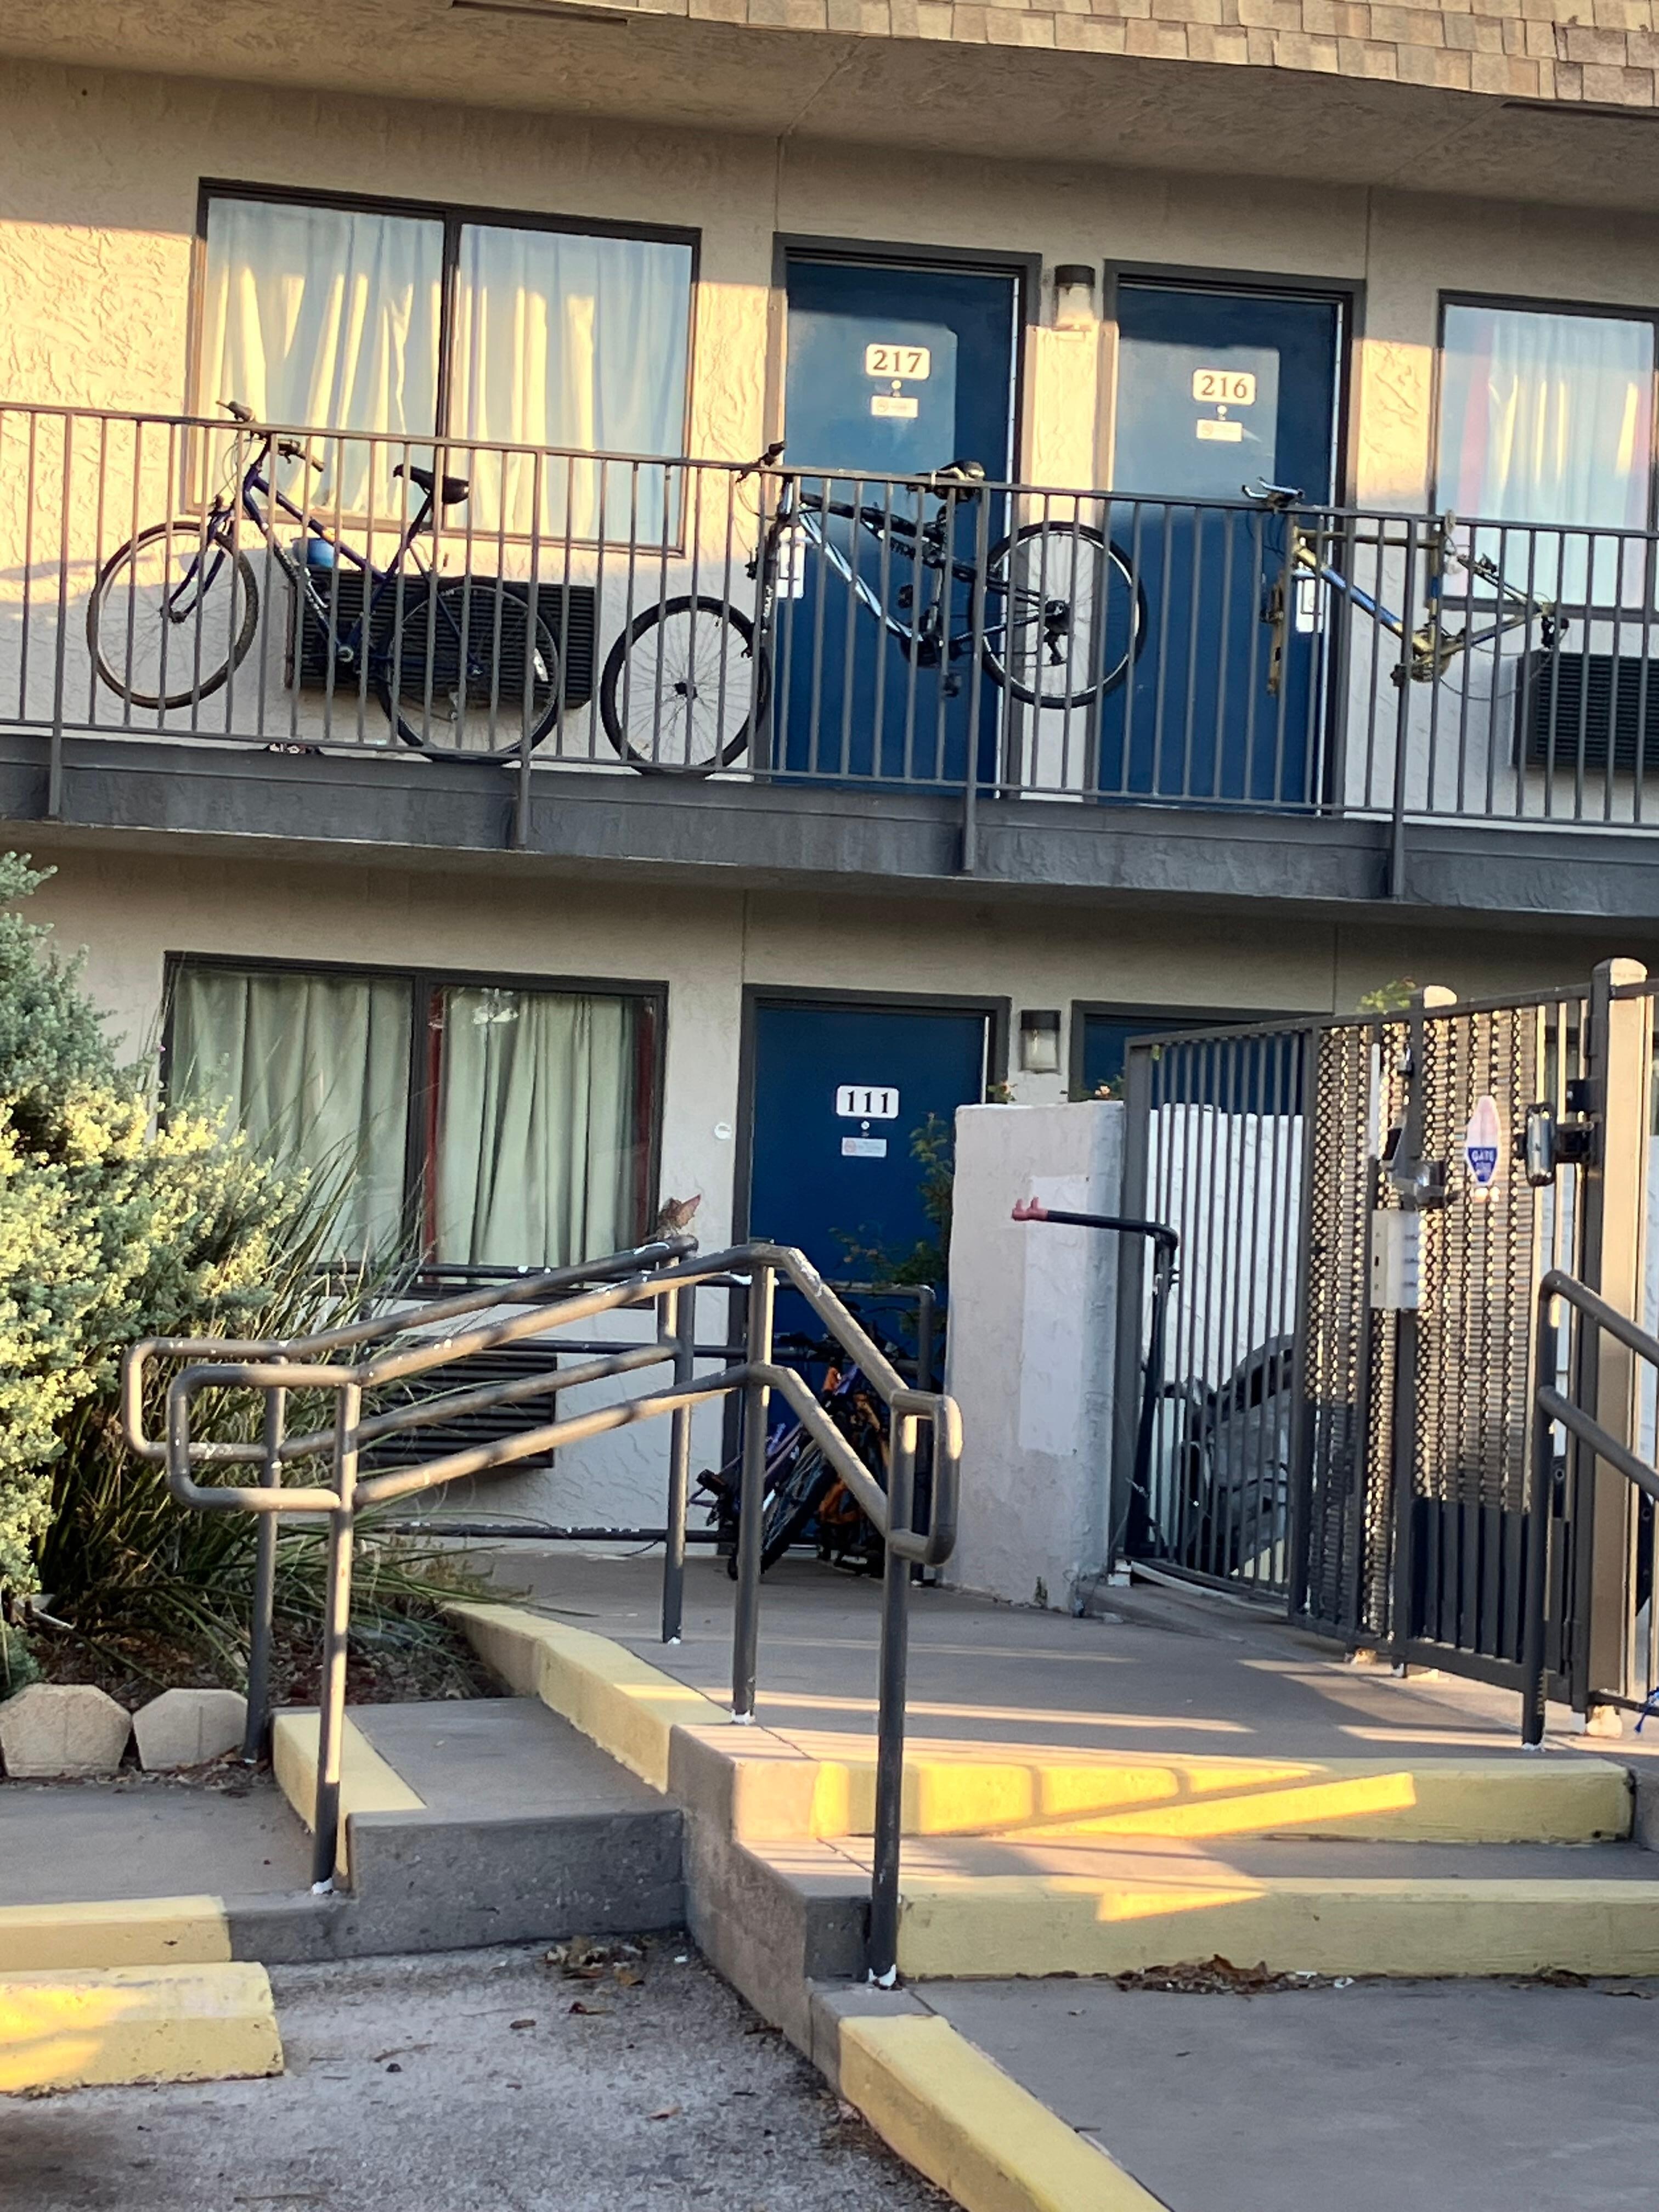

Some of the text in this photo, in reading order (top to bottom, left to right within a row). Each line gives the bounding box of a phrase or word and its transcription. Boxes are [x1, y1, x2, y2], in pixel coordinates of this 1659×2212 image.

[872, 349, 922, 373] 217
[1201, 375, 1248, 398] 216
[847, 1089, 889, 1114] 111
